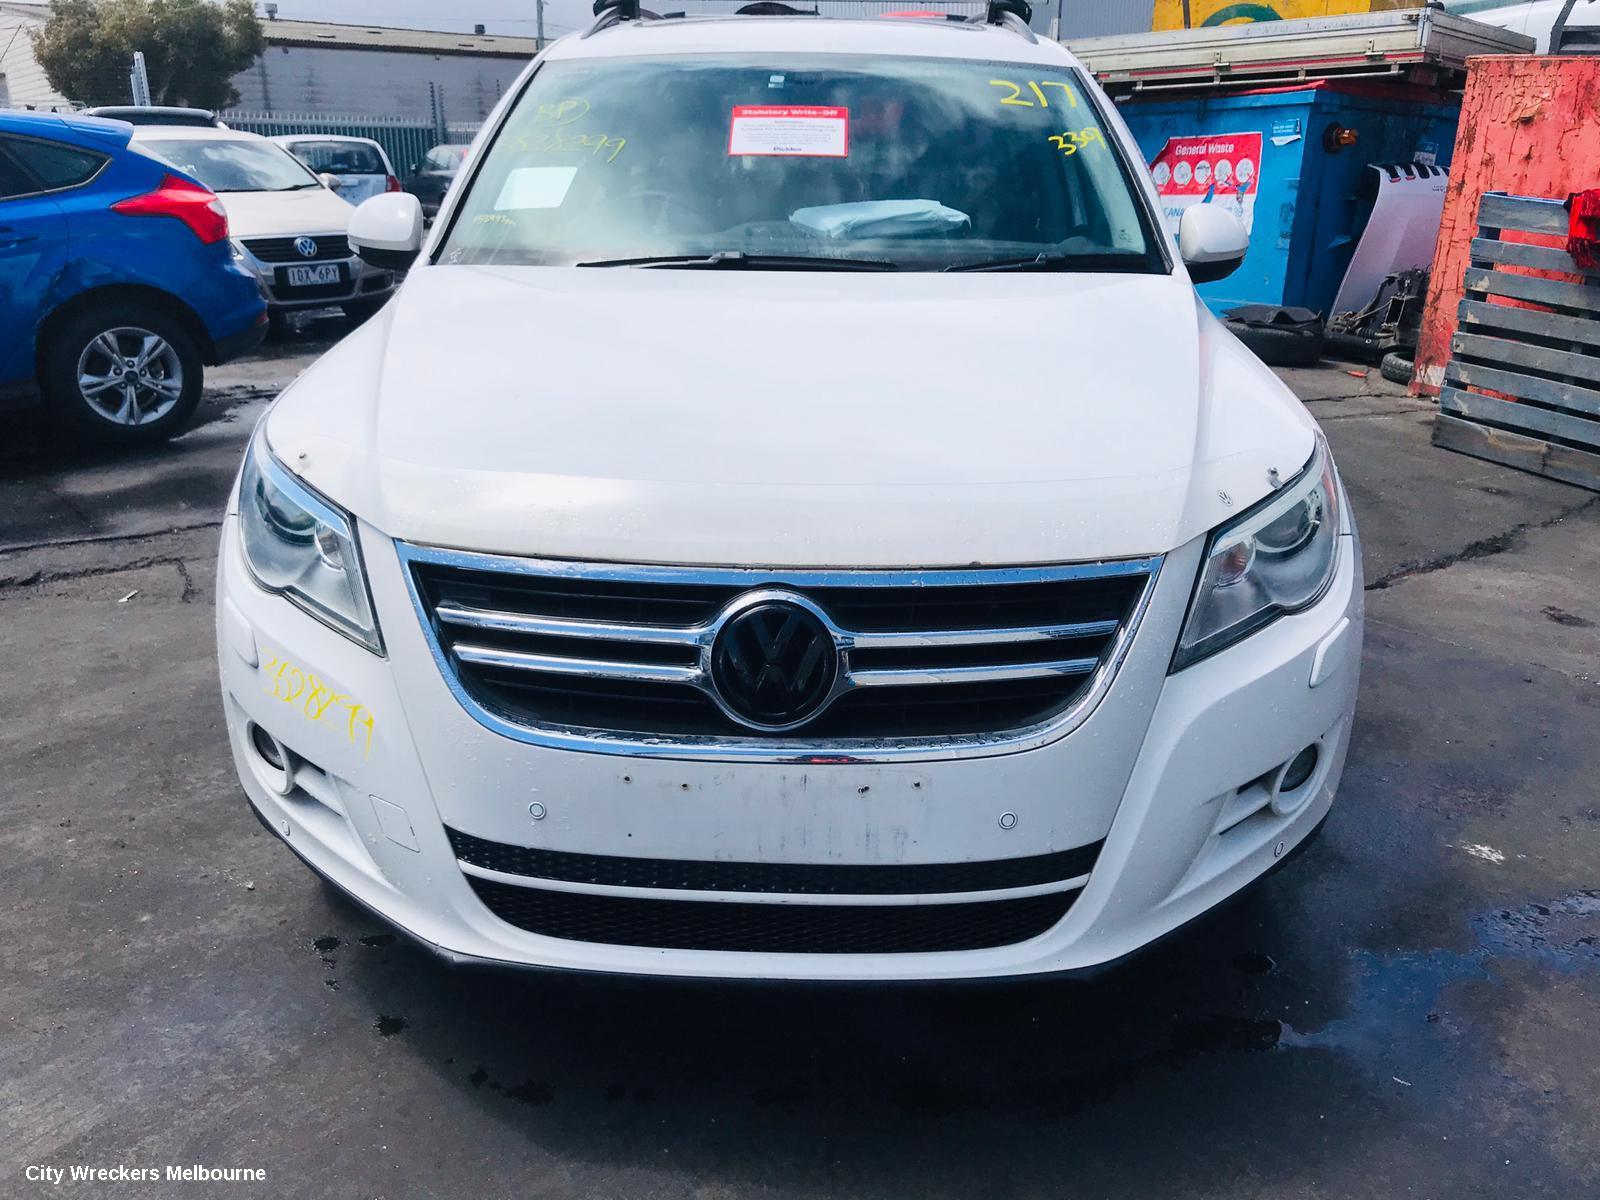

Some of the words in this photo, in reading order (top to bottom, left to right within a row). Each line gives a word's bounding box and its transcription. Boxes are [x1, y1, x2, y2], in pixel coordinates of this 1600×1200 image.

[989, 80, 1077, 108] 217
[1175, 143, 1207, 156] General
[1208, 143, 1235, 154] Waste
